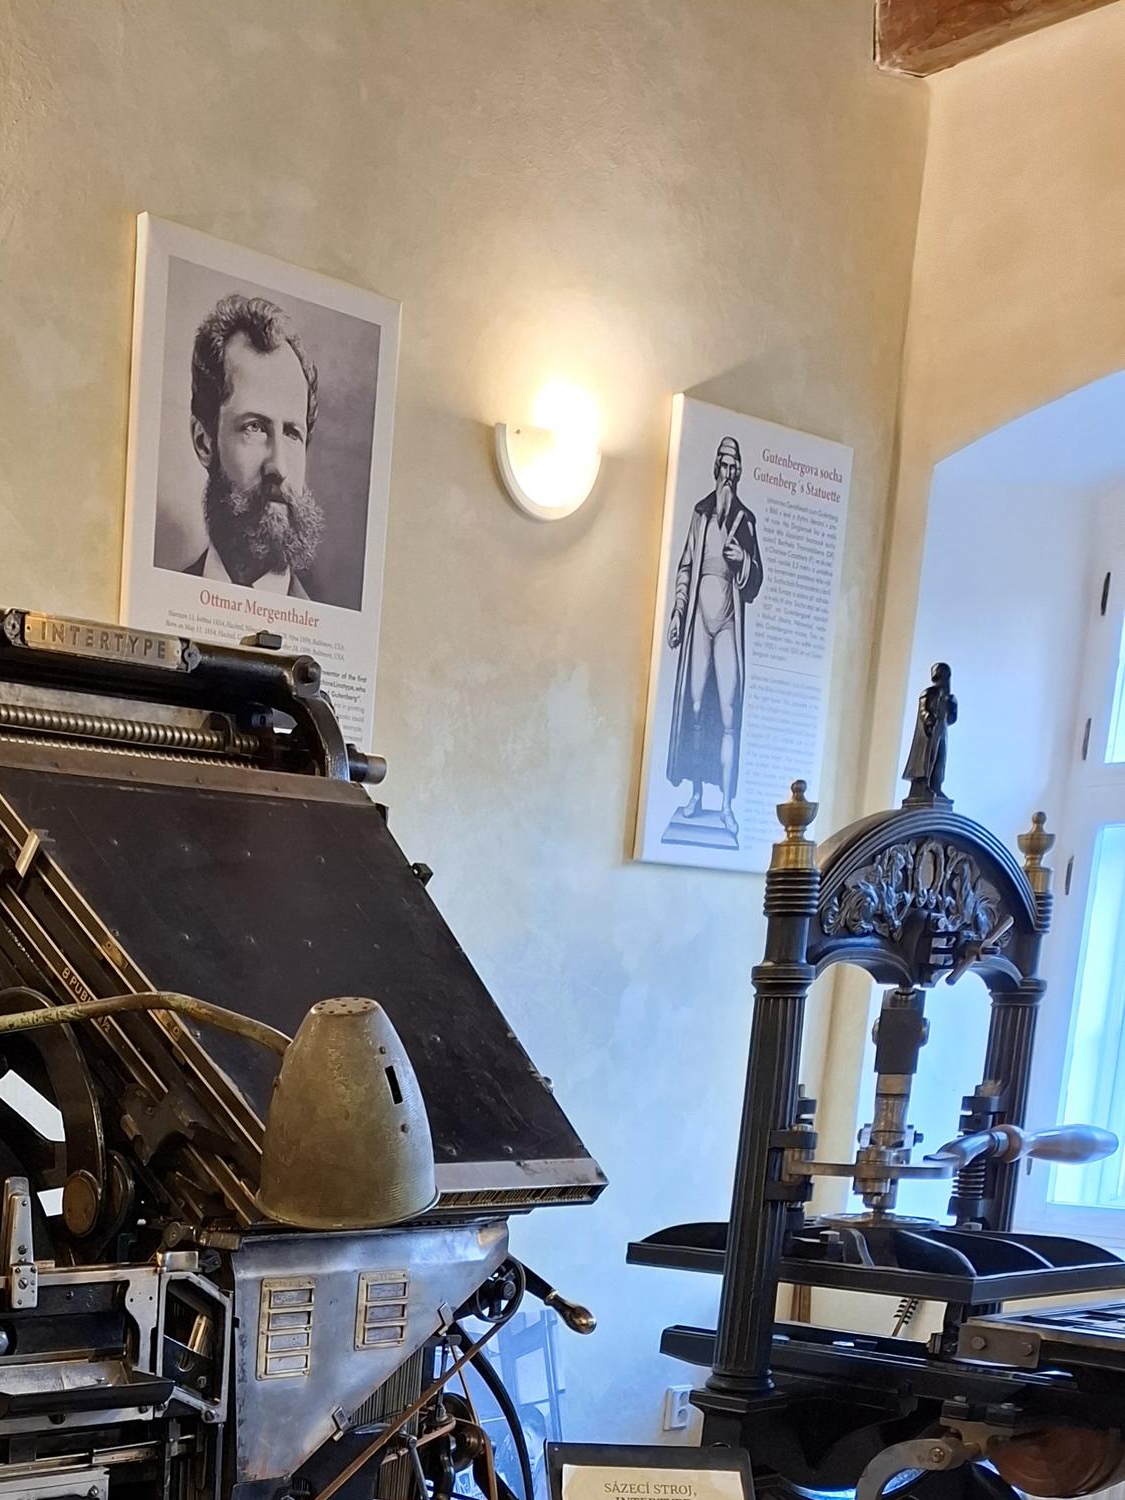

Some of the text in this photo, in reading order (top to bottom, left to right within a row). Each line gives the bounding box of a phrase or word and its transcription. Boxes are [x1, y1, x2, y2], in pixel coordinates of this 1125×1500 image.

[762, 448, 843, 483] Gutenbergova socha
[806, 481, 841, 503] Statuette
[200, 589, 320, 627] Ottmar Mergenthaler
[41, 621, 166, 659] INTERTYPE
[604, 1481, 697, 1497] SÁZECÍ STROJ,
